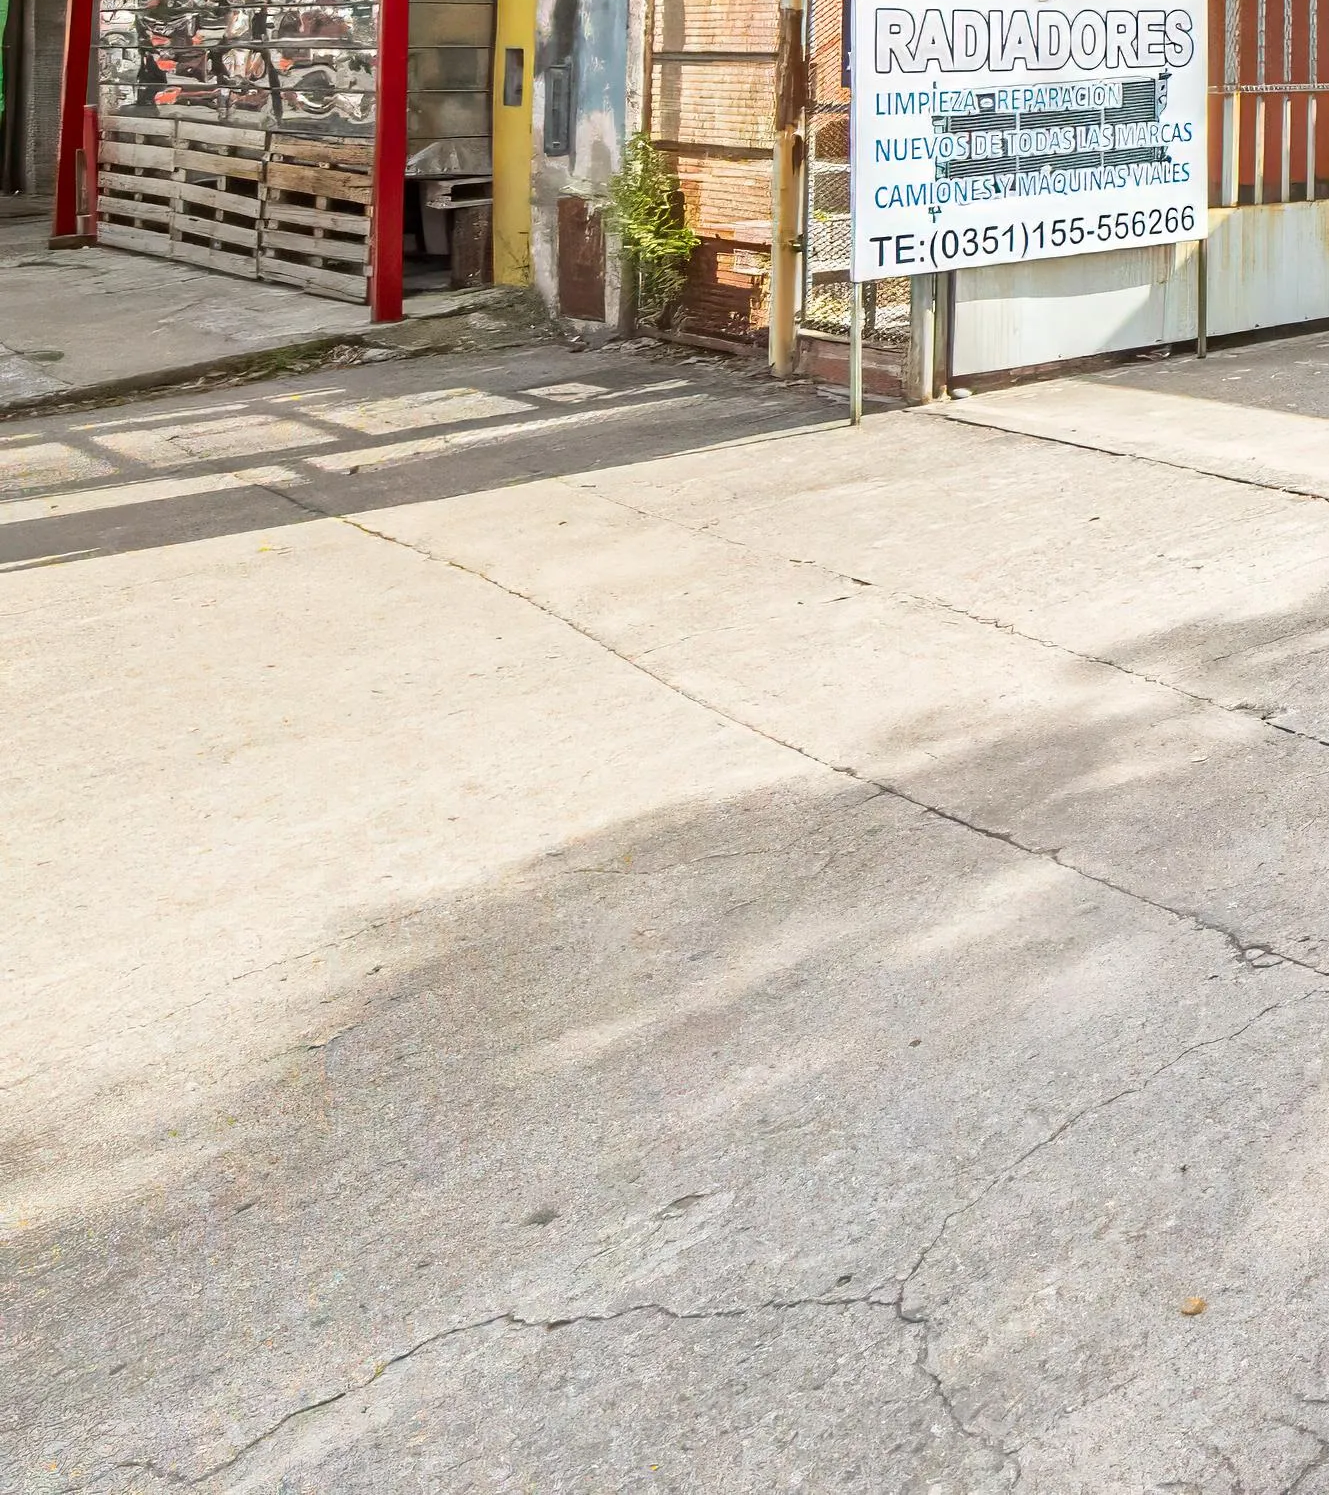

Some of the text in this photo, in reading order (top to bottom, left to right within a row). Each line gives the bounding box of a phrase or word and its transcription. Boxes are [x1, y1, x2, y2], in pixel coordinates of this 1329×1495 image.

[875, 8, 1194, 73] RADIADORES
[875, 90, 977, 116] LIMPIEZA
[875, 121, 1193, 163] NUEVOS DE TODAS LAS MARCAS
[874, 178, 993, 209] CAMIONES
[999, 174, 1014, 199] Y
[1129, 162, 1190, 187] VIALES
[869, 204, 1195, 269] TE:(0351)155-556266
